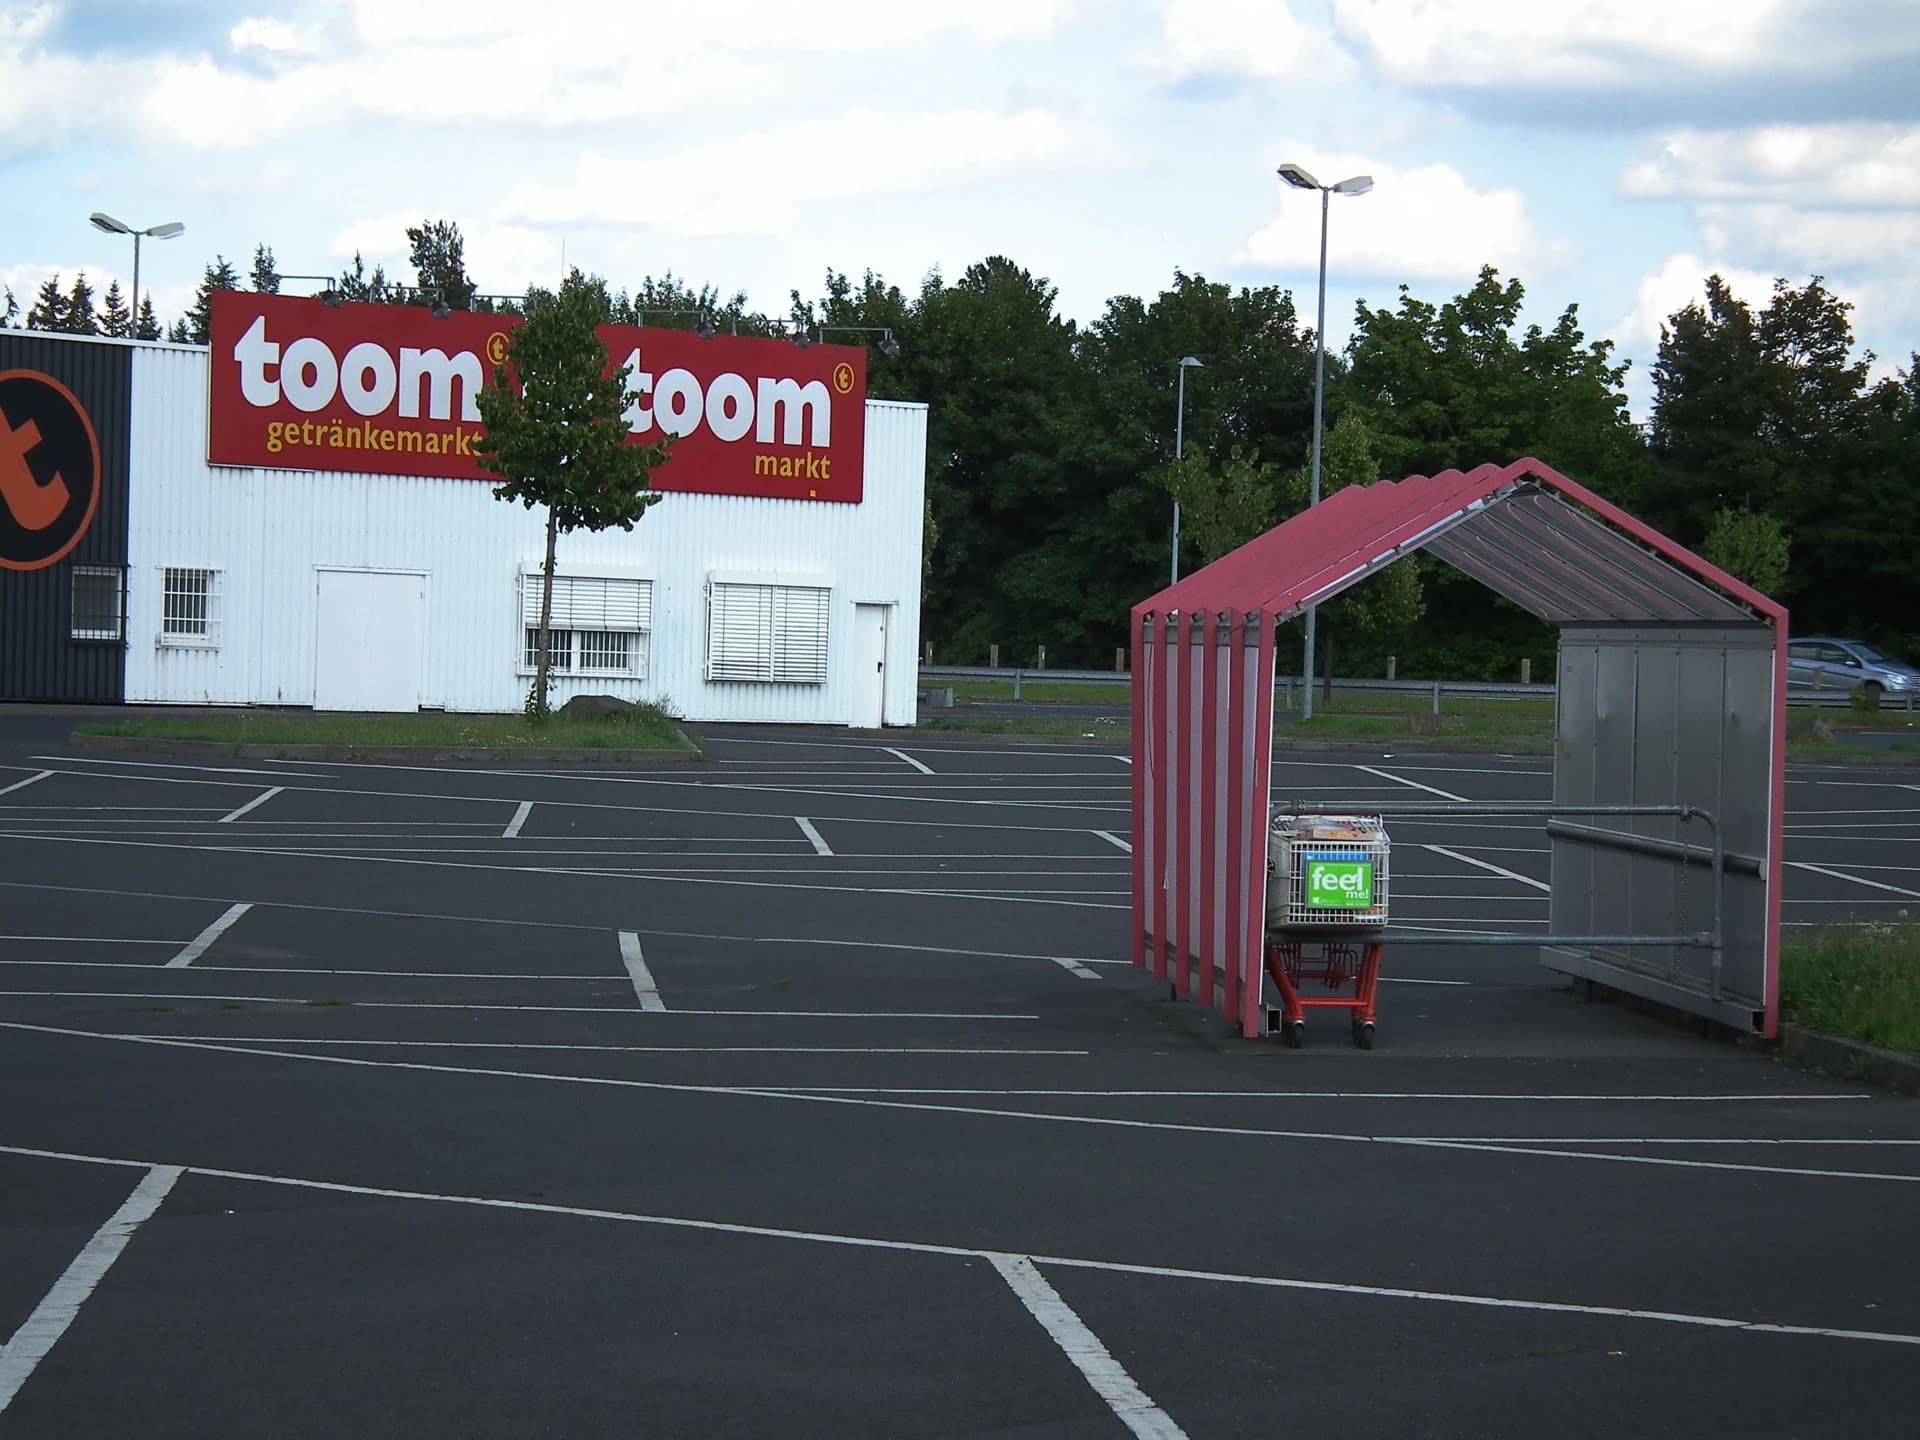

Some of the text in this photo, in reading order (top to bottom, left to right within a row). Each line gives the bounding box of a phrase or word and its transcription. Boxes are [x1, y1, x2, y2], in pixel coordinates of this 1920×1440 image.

[234, 315, 484, 423] toom
[620, 347, 832, 448] toom
[754, 451, 831, 480] markt
